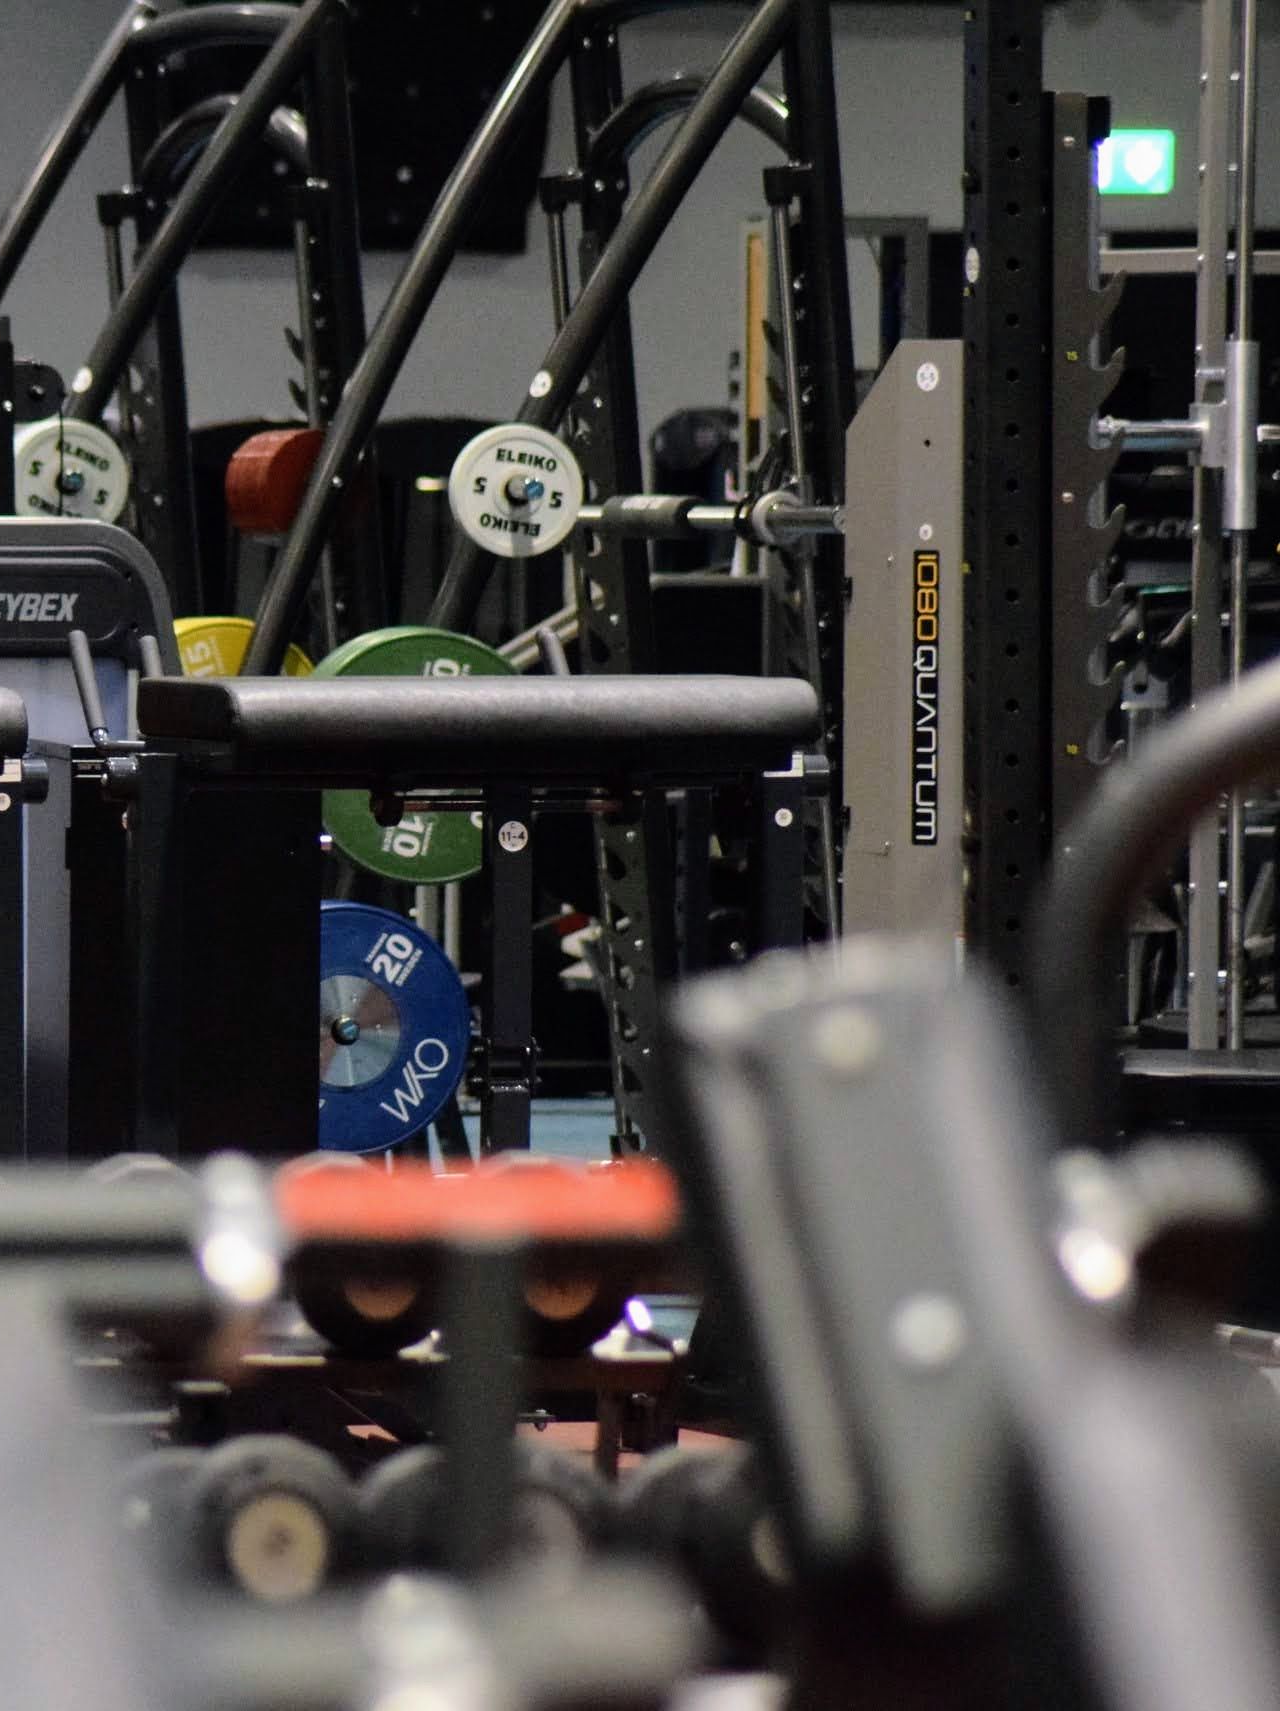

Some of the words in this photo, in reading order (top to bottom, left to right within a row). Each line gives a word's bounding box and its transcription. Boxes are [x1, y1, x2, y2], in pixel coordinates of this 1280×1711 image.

[496, 448, 557, 472] ELEIKO
[473, 477, 487, 495] 5
[549, 491, 563, 508] 5
[480, 513, 541, 537] ELEIKO
[917, 553, 938, 642] 1080
[913, 645, 937, 840] QUANTUM
[501, 831, 525, 841] 11-4
[372, 934, 414, 984] 20
